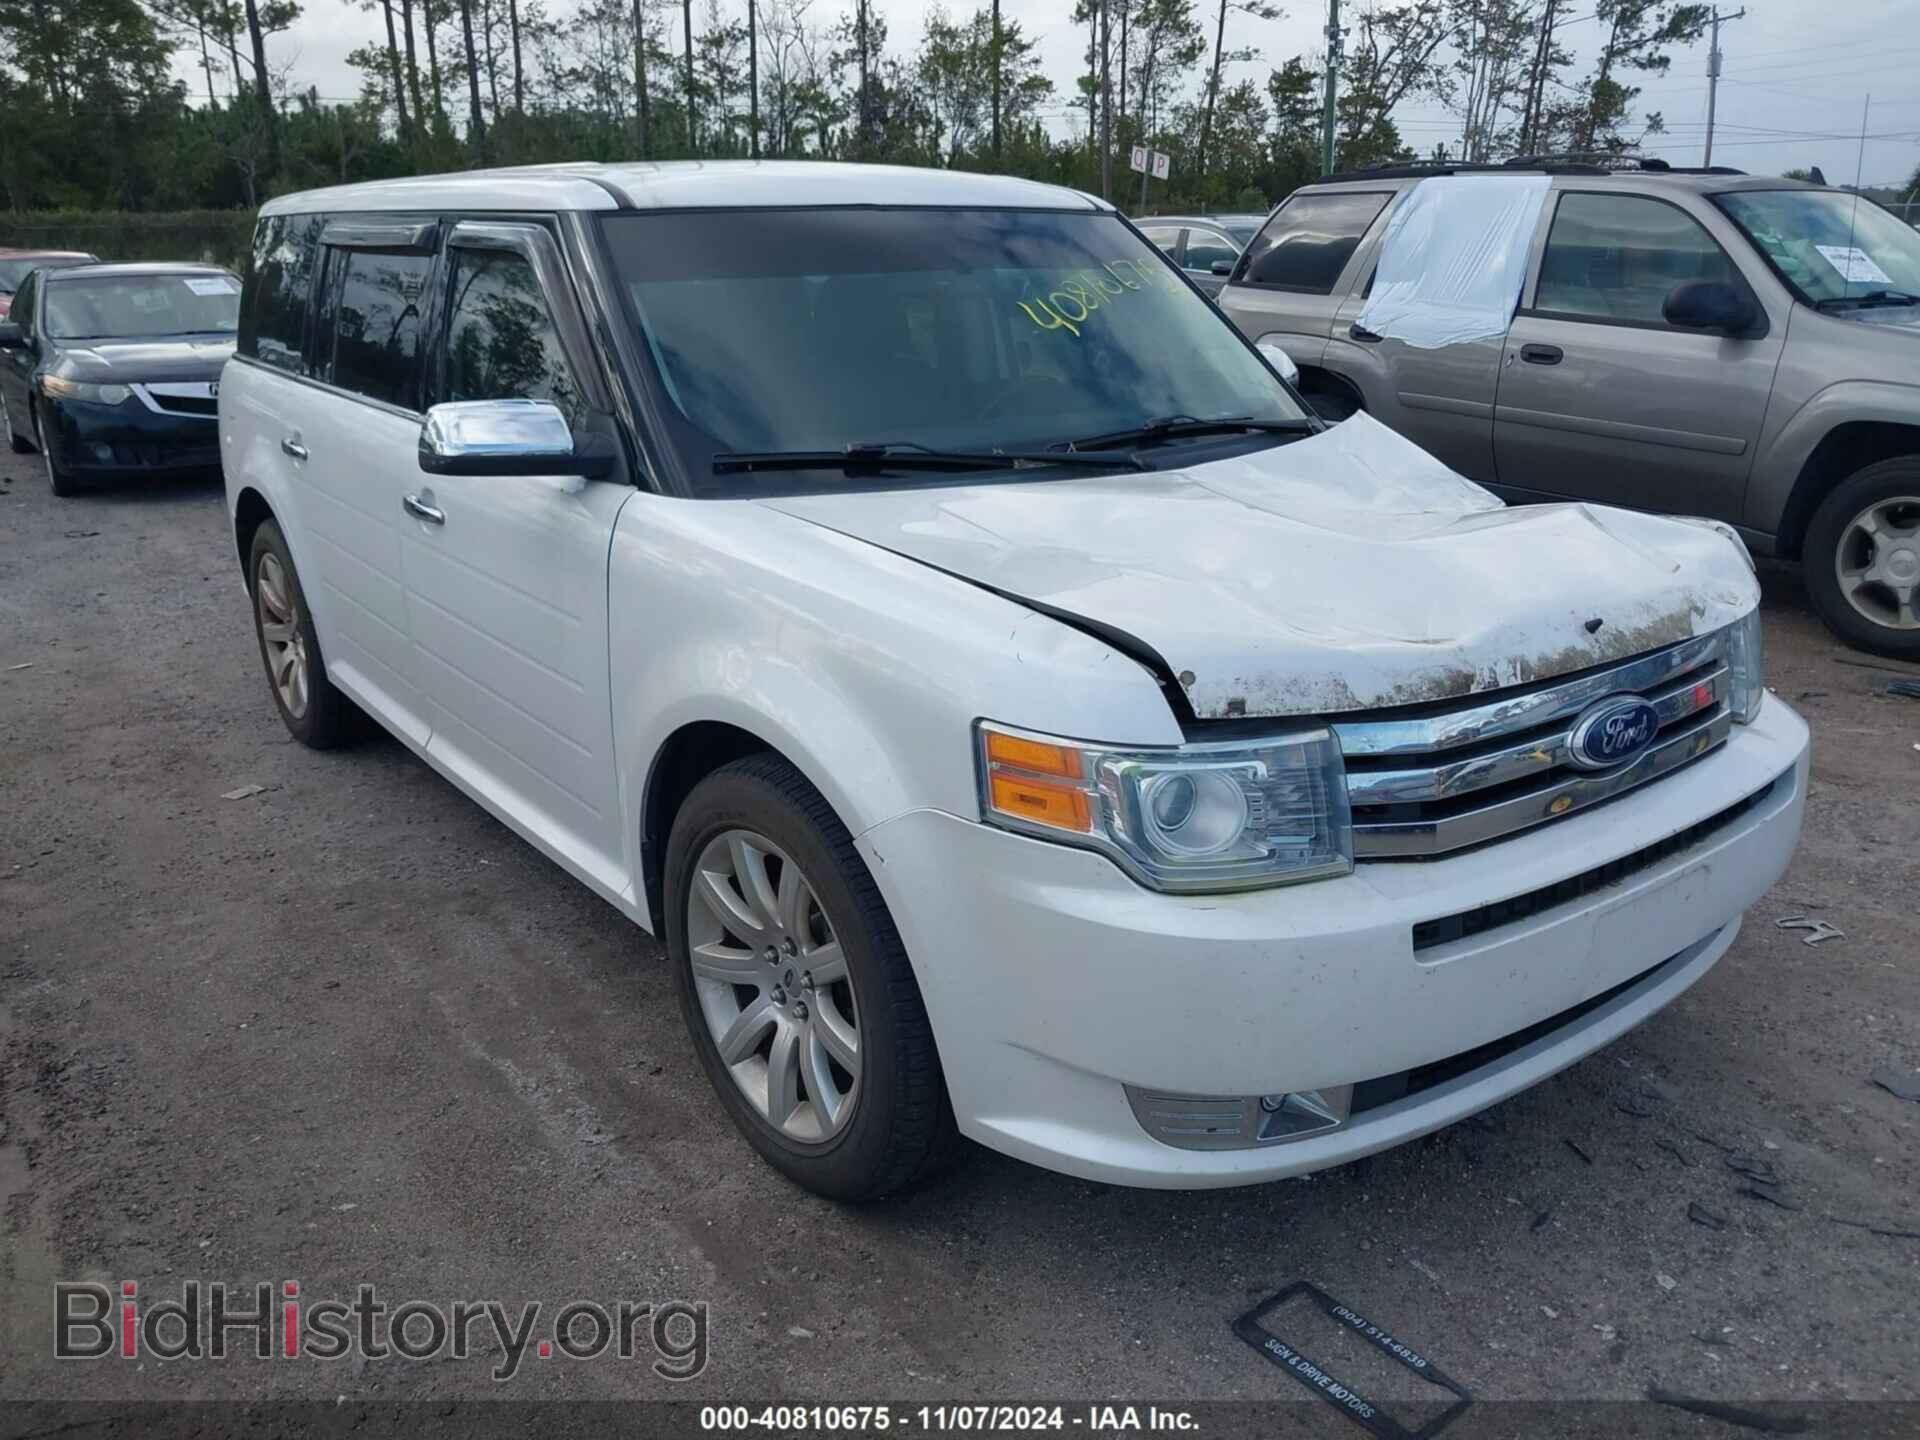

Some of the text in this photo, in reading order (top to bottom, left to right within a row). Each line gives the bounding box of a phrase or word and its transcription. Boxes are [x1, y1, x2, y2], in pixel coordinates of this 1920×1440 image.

[1135, 150, 1164, 174] Q P
[1603, 711, 1648, 754] Ford
[1332, 1304, 1367, 1329] (904)
[1264, 1338, 1375, 1419] SIGN & DRIVE MOTORS
